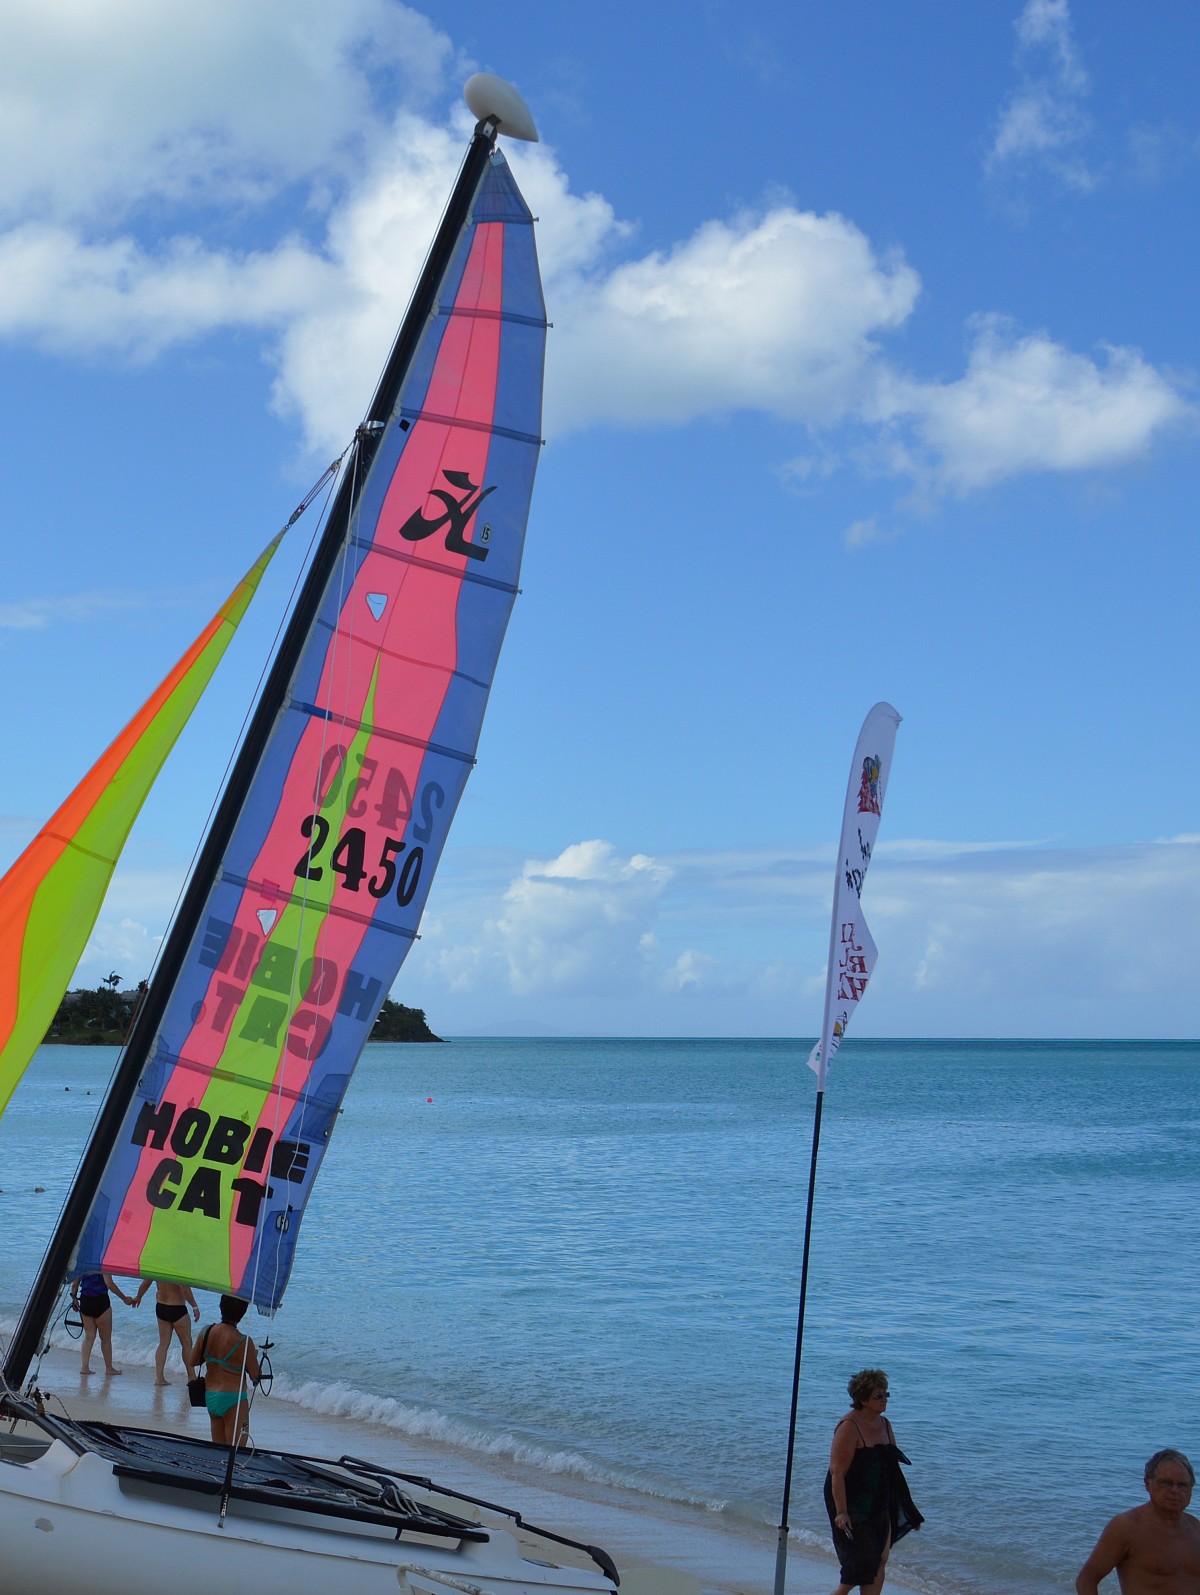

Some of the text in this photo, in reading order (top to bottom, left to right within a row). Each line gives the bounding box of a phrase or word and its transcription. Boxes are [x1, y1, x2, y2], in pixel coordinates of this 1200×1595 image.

[293, 814, 424, 907] 2450
[131, 1101, 311, 1184] HOBIE
[146, 1158, 274, 1227] CAT
